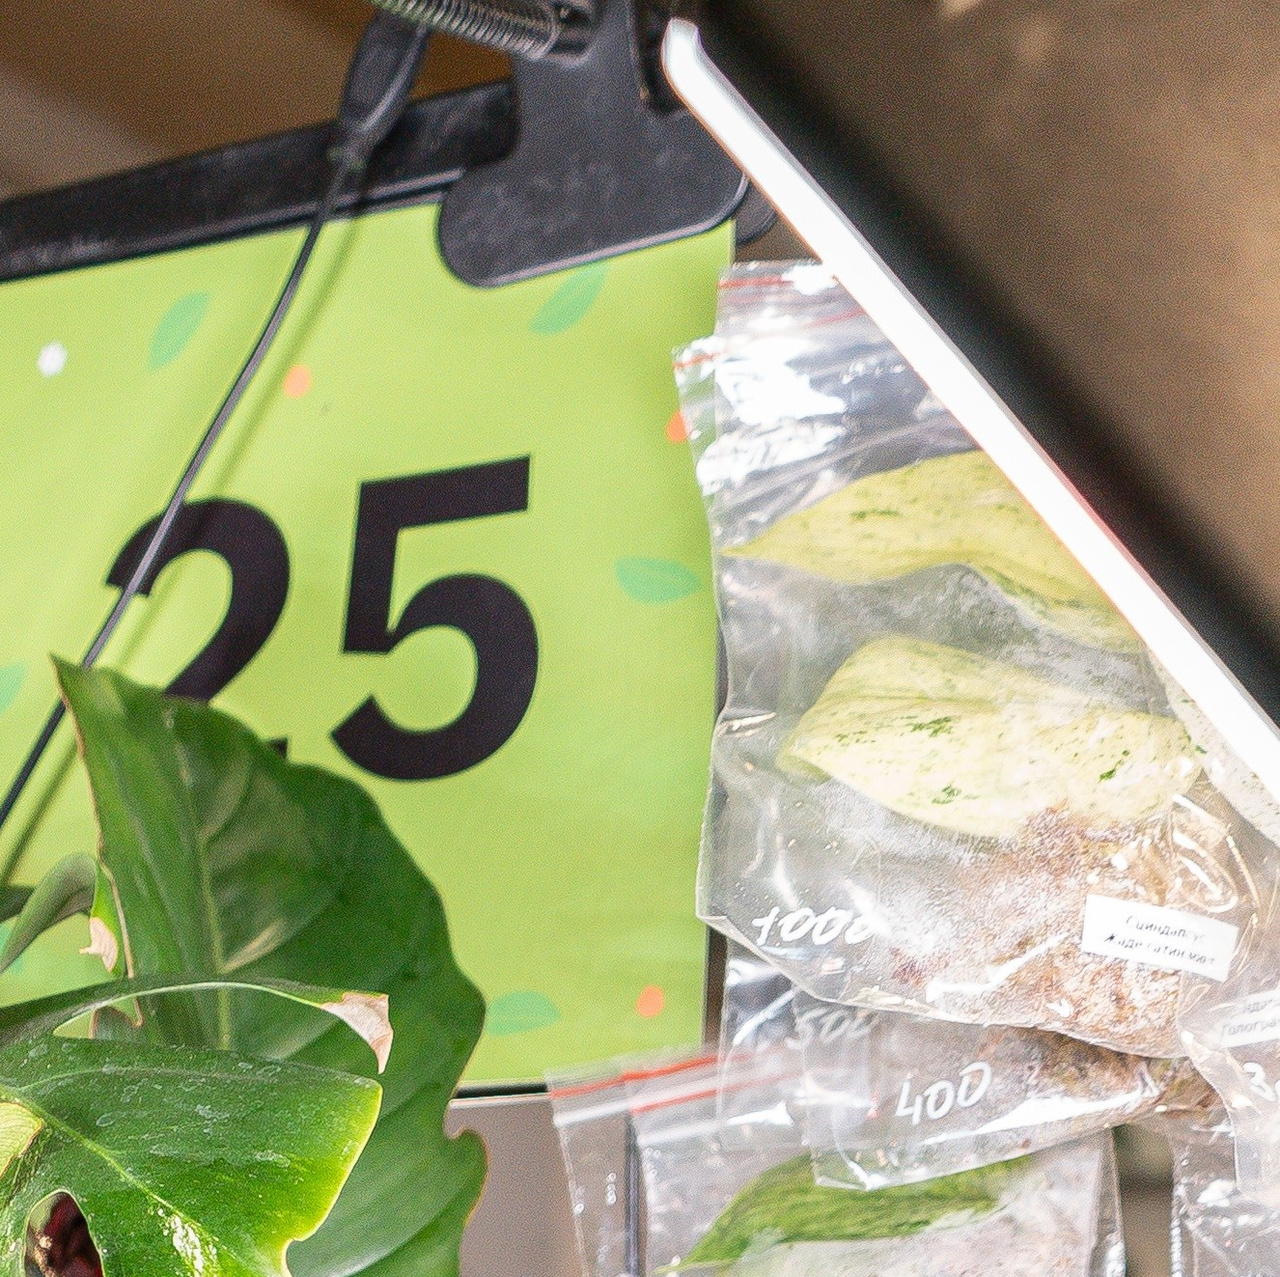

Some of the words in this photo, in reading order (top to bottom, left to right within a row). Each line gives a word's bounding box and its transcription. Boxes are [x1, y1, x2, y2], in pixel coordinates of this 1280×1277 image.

[106, 454, 539, 782] 25
[752, 906, 880, 946] 1000
[895, 1061, 991, 1126] 400
[1242, 1062, 1280, 1102] 3
